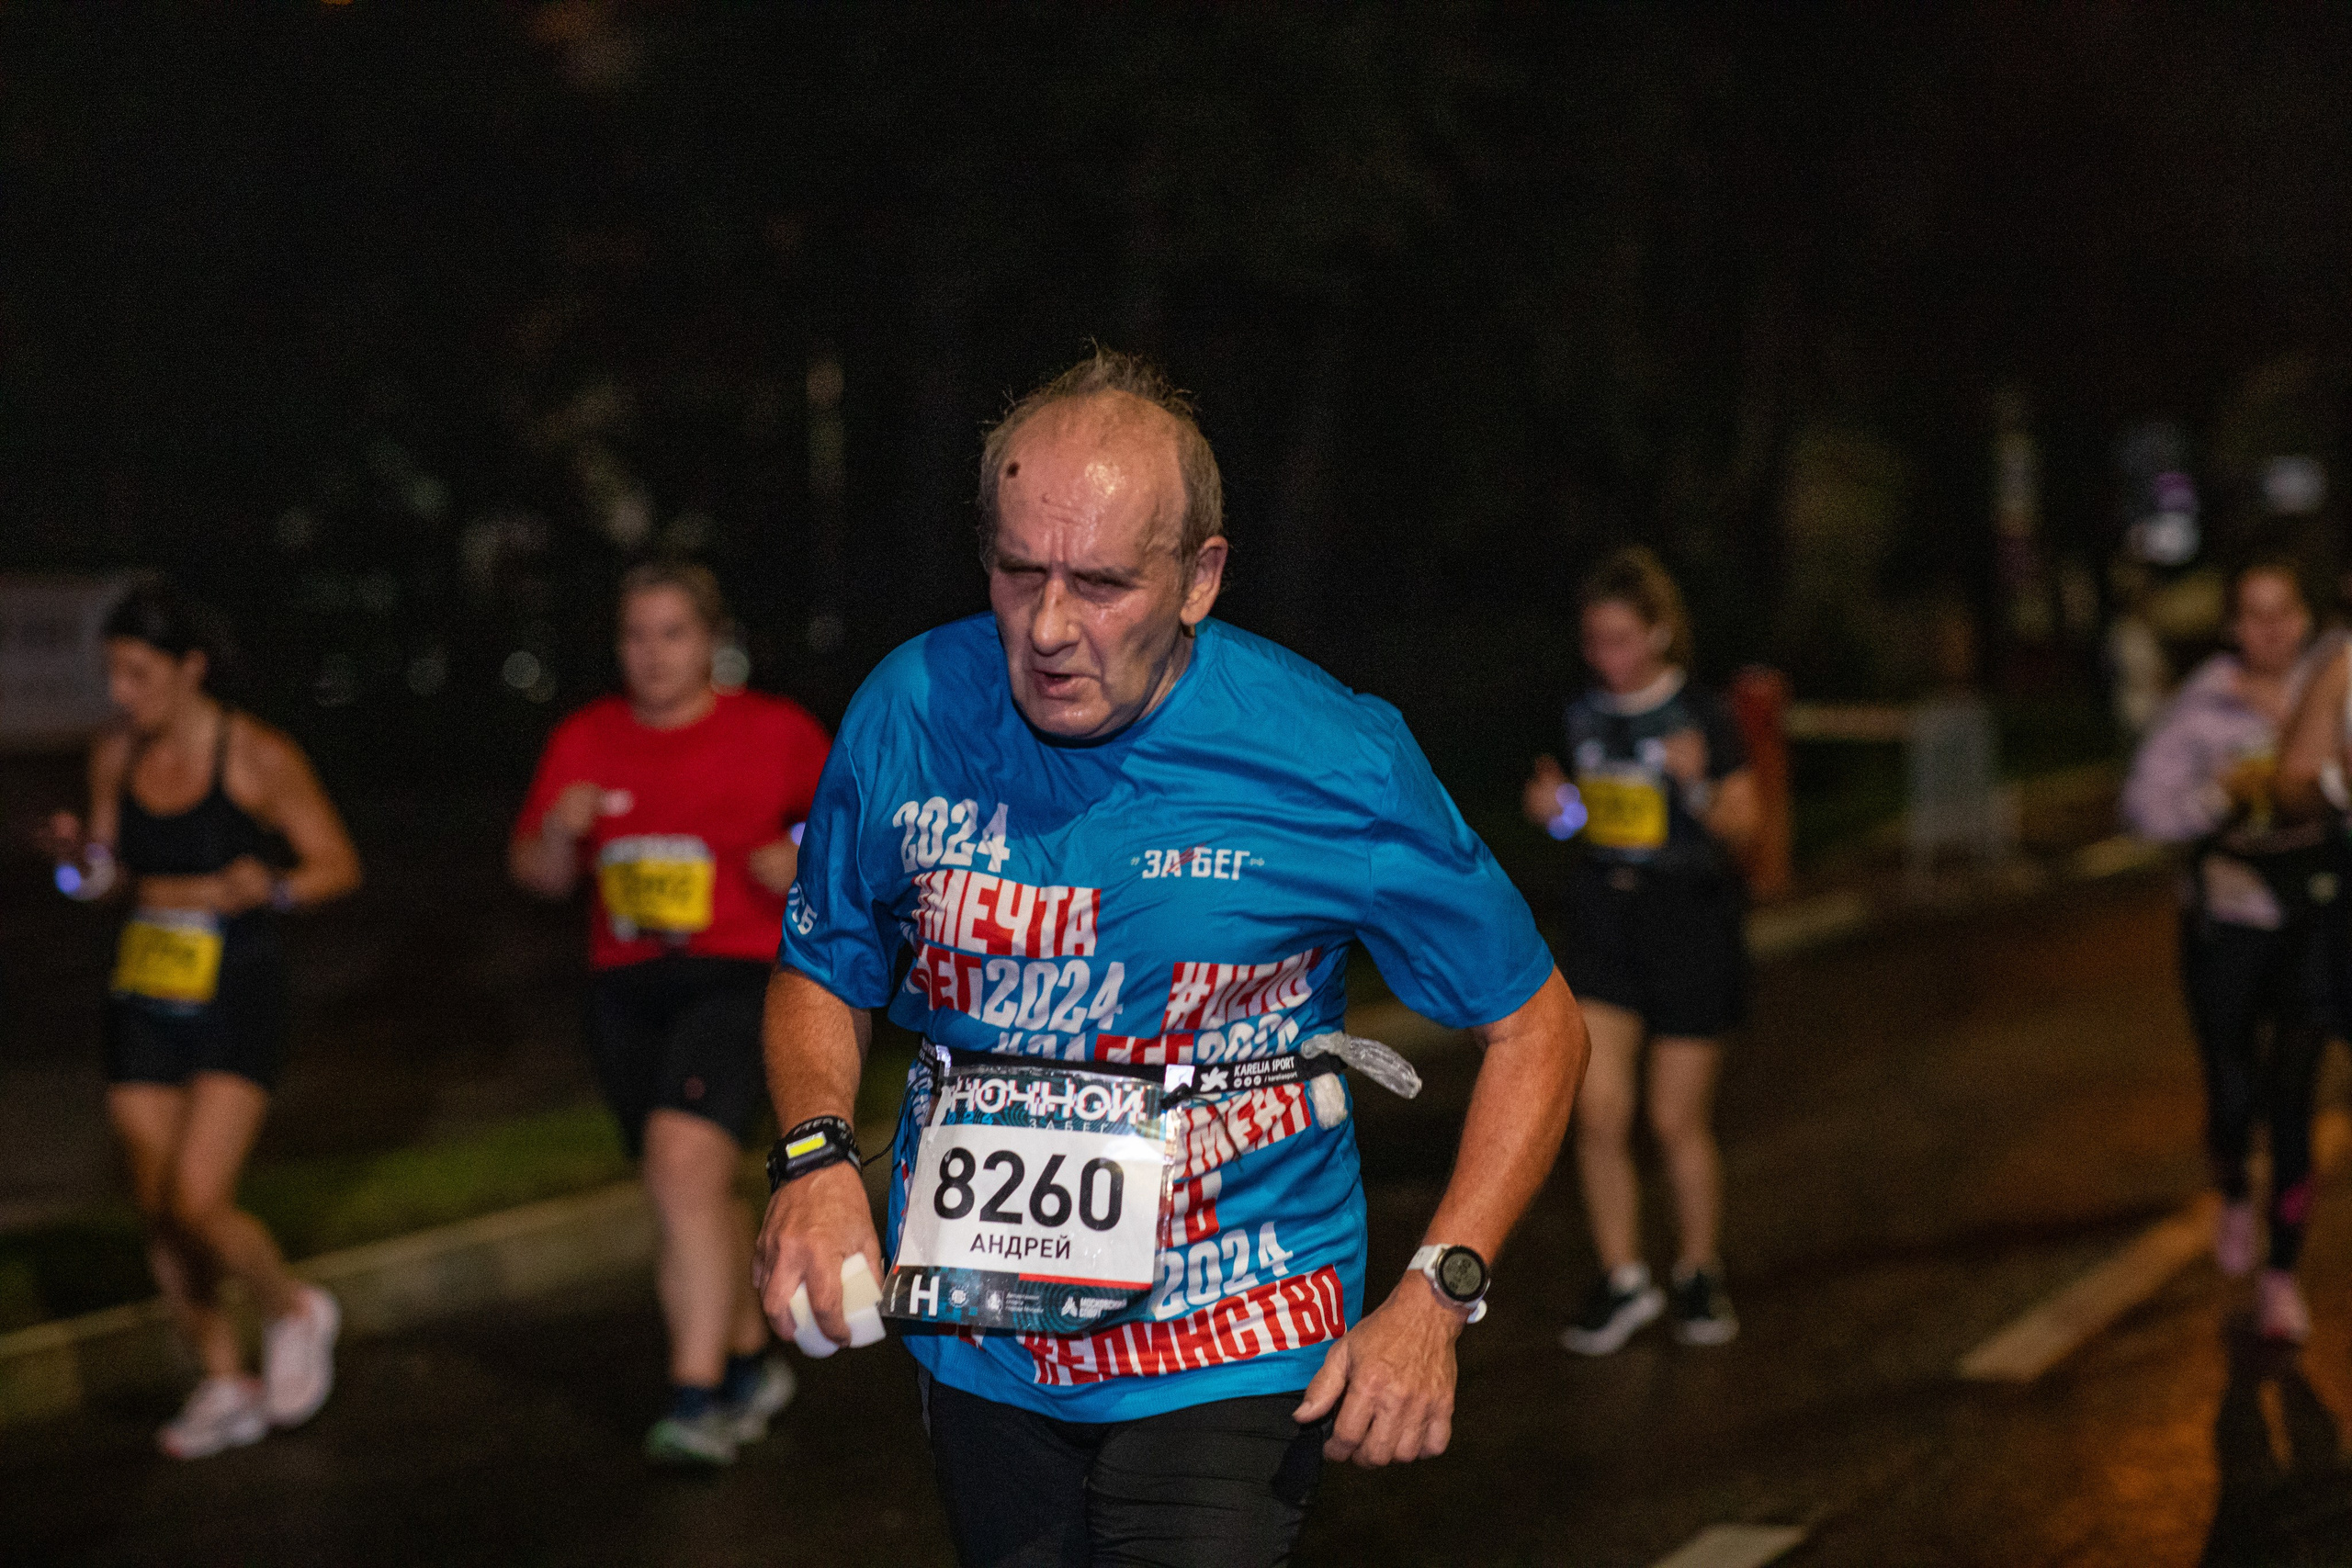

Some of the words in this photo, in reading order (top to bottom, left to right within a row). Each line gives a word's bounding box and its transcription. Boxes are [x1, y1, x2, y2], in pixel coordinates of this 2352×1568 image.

[892, 796, 1010, 873] 2024
[1233, 1060, 1270, 1077] KARELIA
[1272, 1055, 1295, 1072] SPORT
[948, 1077, 1150, 1124] НОЧНОЙ
[1029, 1118, 1108, 1134] ЗАБЕГ
[933, 1147, 1125, 1232] 8260
[969, 1233, 1071, 1259] АНДРЕЙ
[1156, 1222, 1293, 1320] 2024
